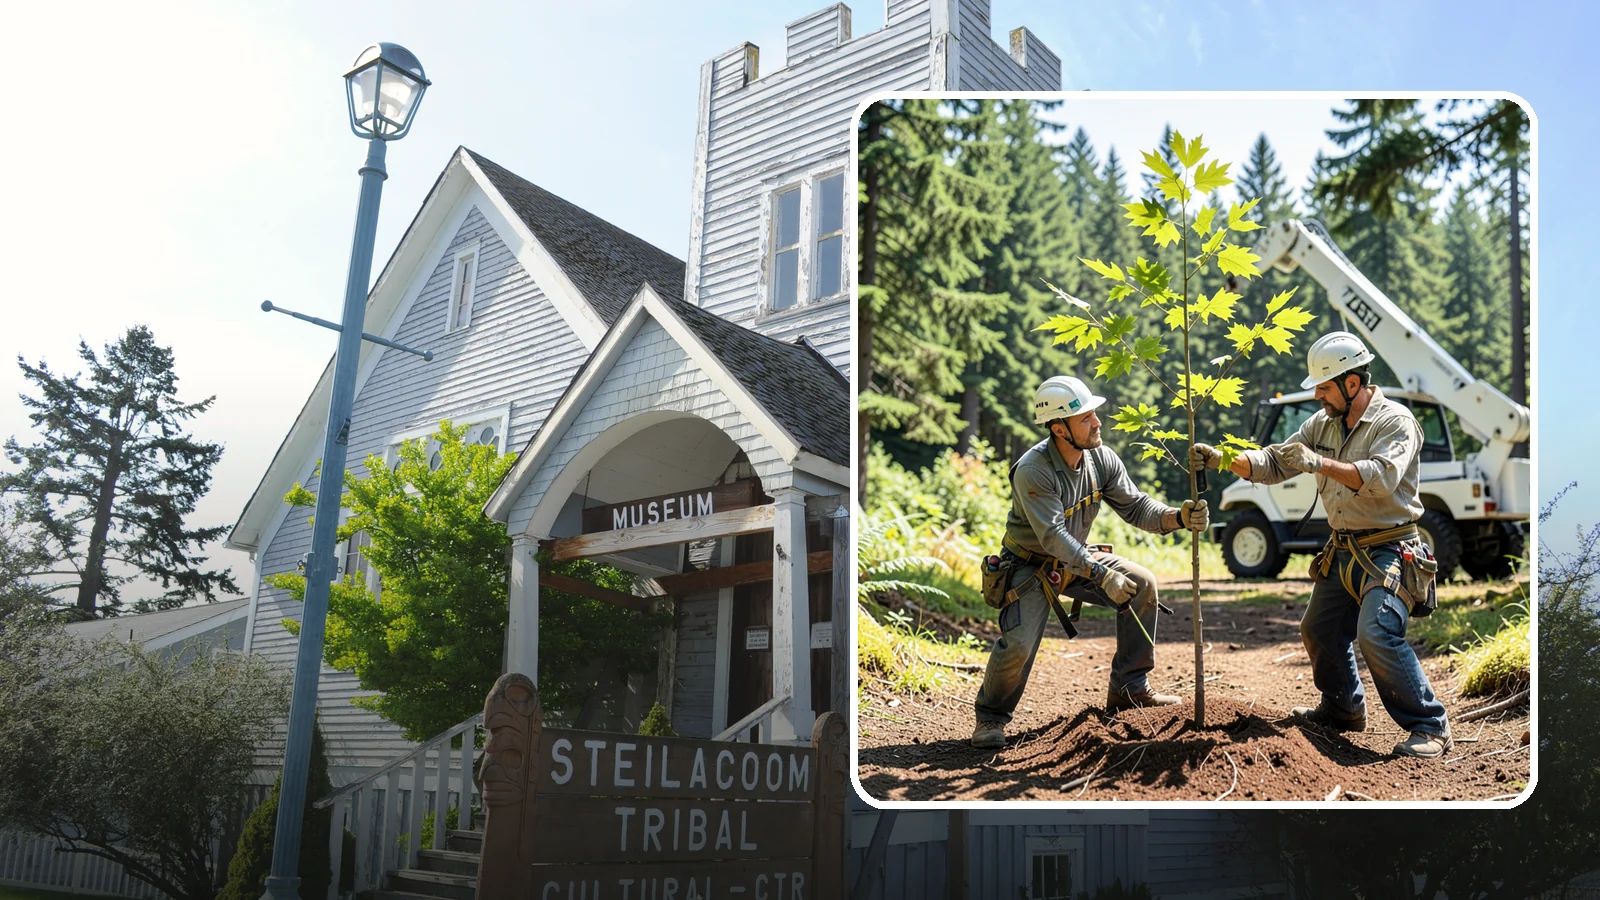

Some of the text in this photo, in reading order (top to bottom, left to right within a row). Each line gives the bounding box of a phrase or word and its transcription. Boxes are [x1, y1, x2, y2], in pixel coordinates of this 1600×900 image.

[613, 491, 713, 530] MUSEUM
[551, 738, 809, 792] STEILACOOM
[615, 807, 758, 852] TRIBAL
